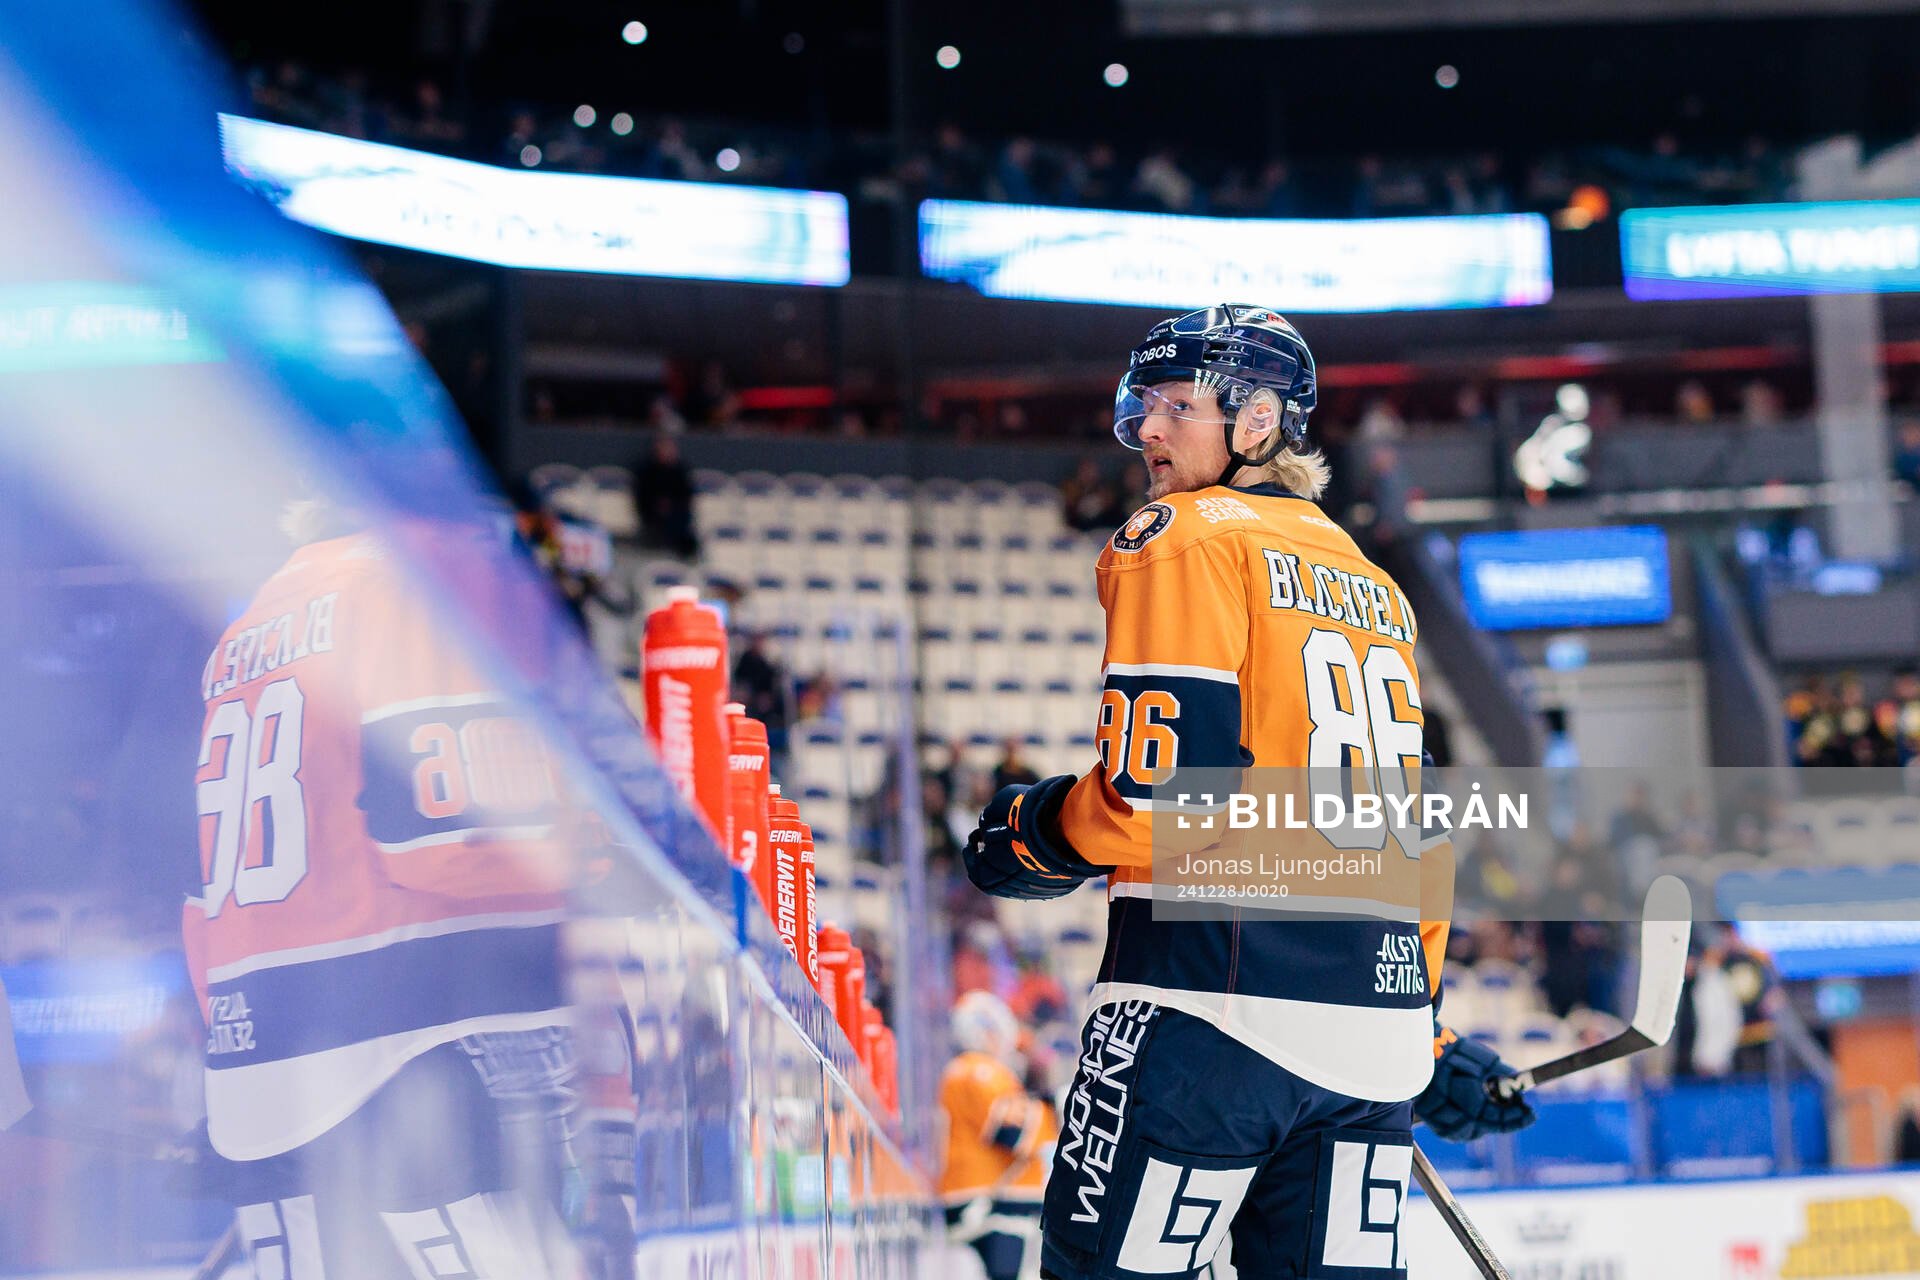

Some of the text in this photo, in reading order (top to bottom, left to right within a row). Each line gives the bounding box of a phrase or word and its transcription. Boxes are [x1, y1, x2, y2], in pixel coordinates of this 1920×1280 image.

[1139, 343, 1177, 364] OBOS
[1095, 688, 1180, 786] 86
[1302, 628, 1424, 860] 86
[776, 848, 797, 938] ENERVIT
[806, 868, 818, 950] ENERVIT
